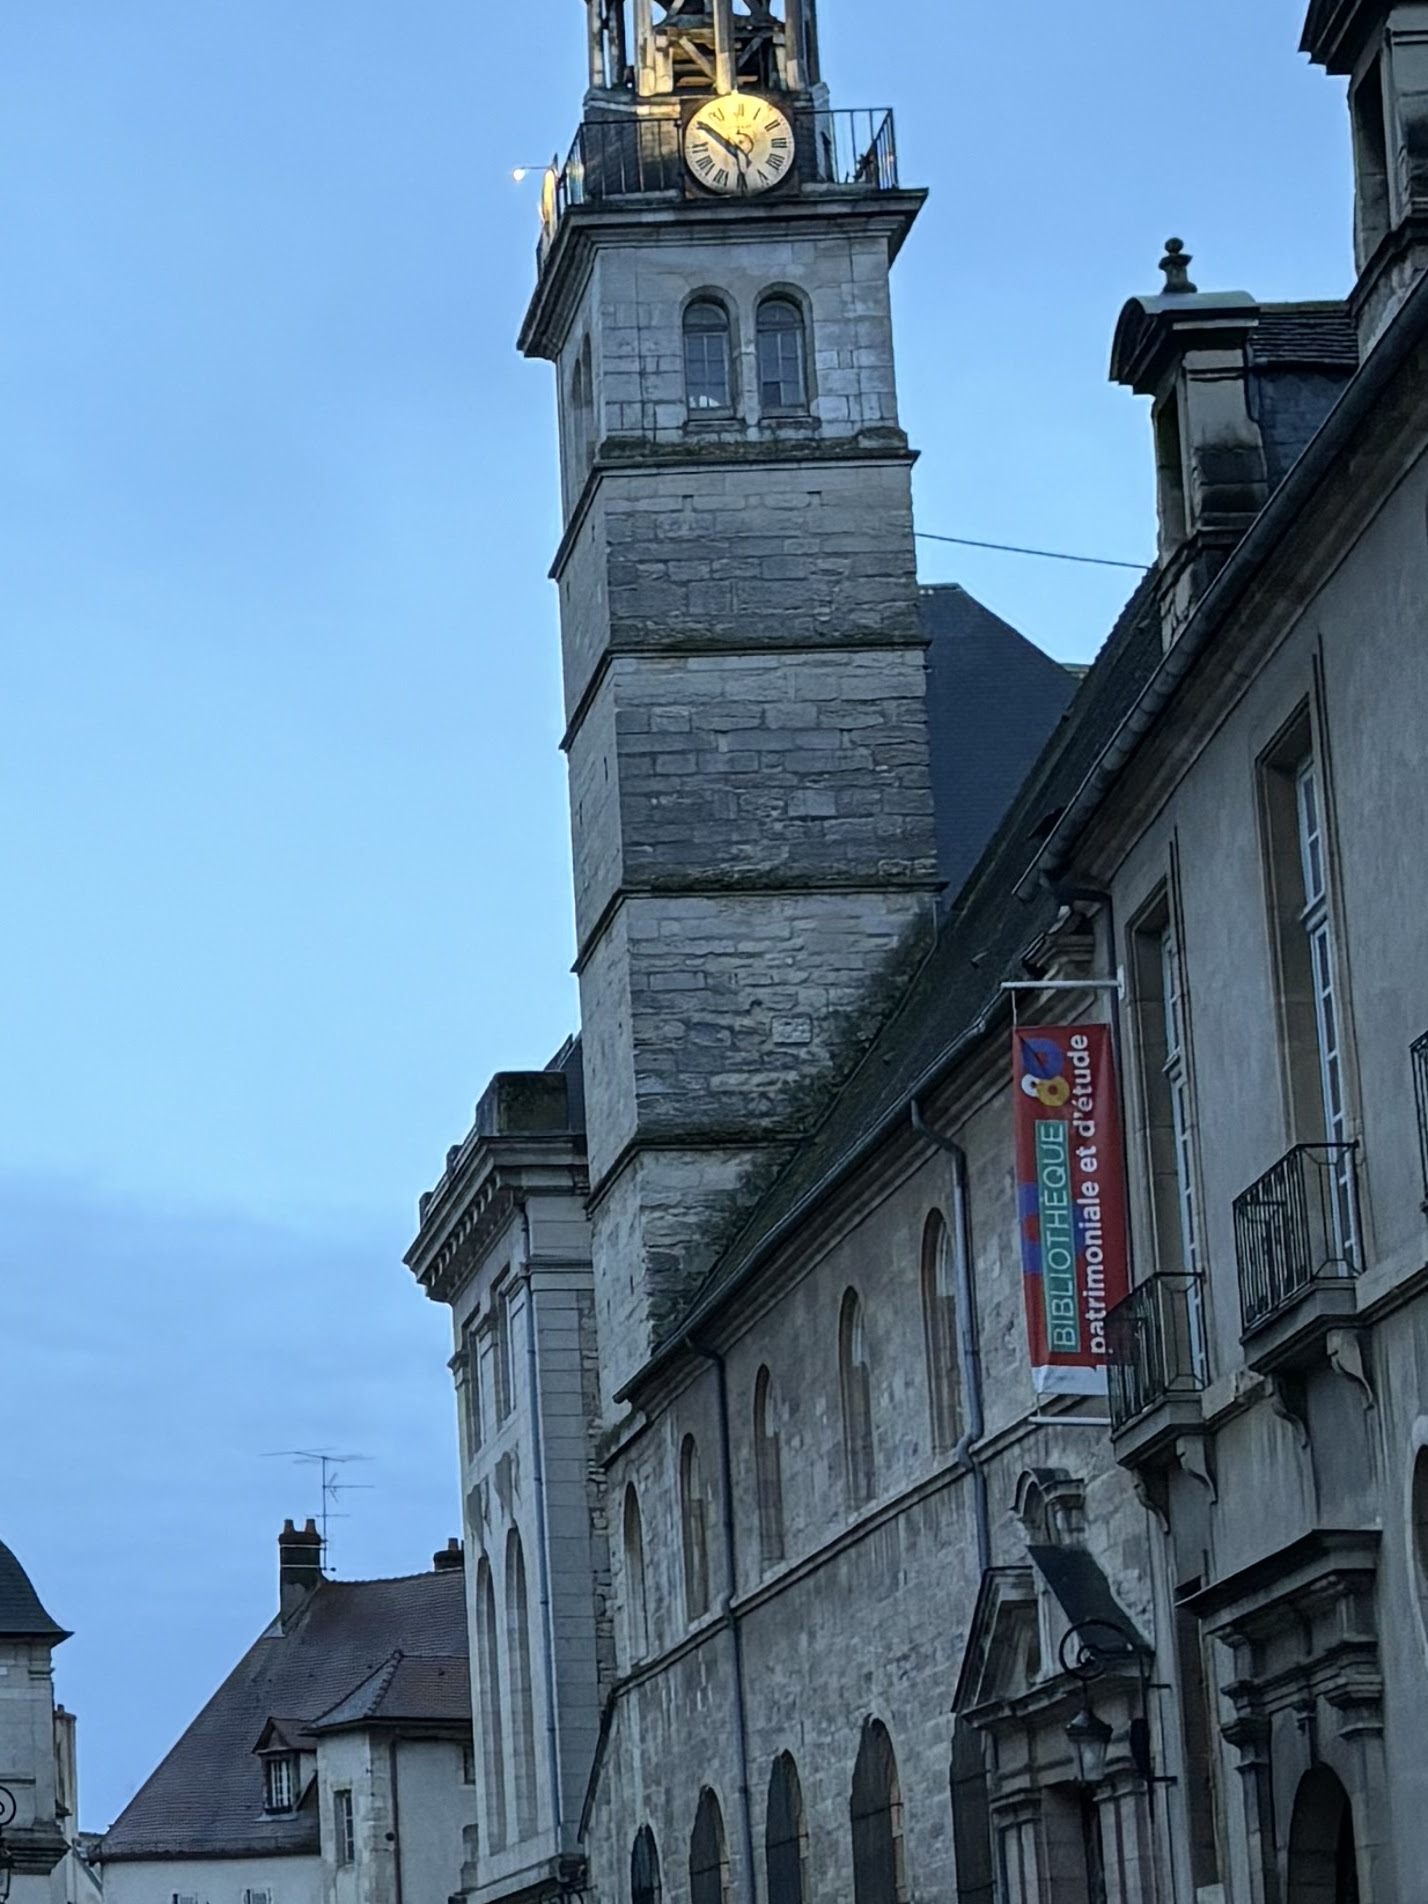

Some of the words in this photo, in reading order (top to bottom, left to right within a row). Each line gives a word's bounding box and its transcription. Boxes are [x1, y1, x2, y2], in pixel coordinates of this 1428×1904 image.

[1066, 1034, 1096, 1138] d'étude
[1078, 1144, 1097, 1173] et
[1039, 1124, 1076, 1349] BIBLIOTHÈQUE
[1076, 1181, 1109, 1354] patrimoniale
